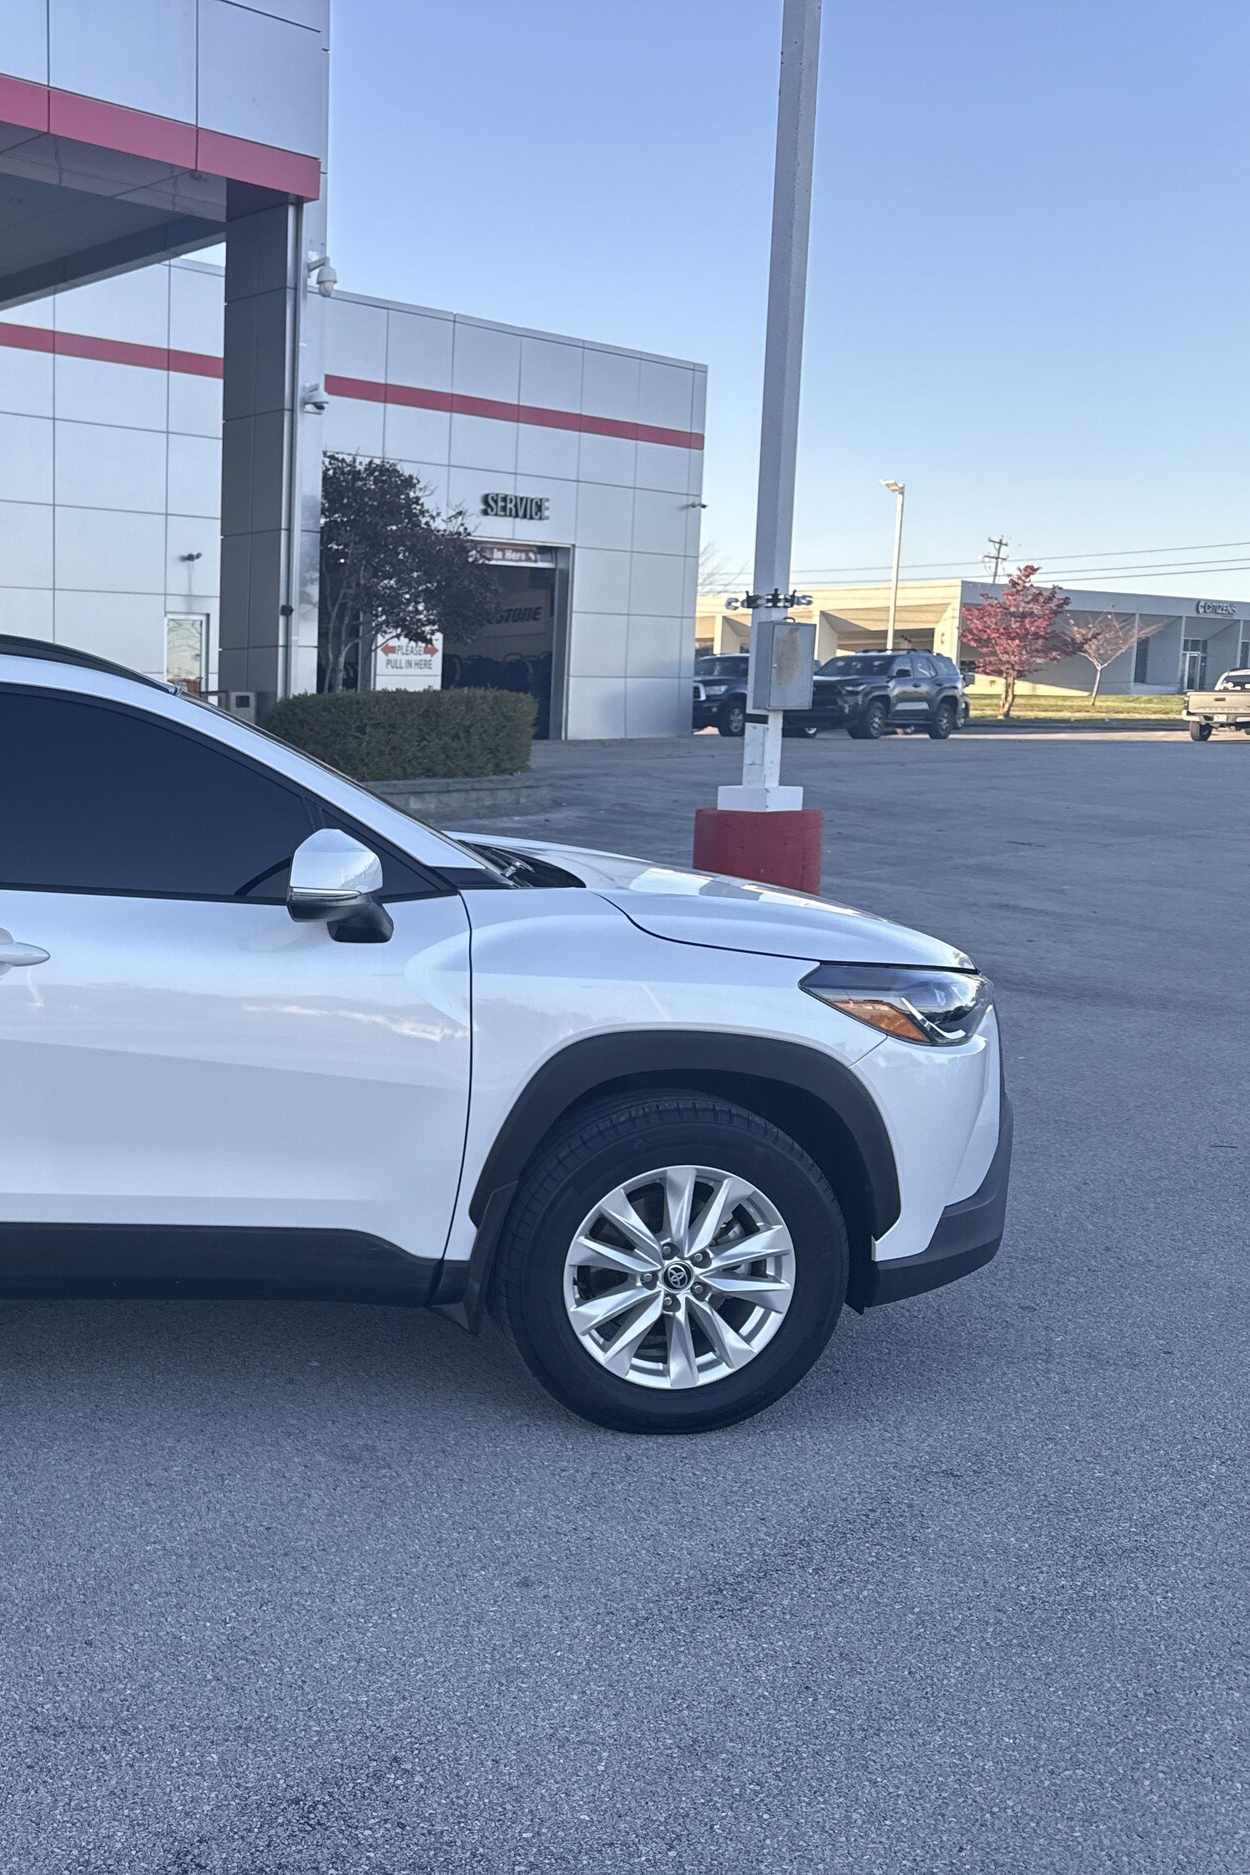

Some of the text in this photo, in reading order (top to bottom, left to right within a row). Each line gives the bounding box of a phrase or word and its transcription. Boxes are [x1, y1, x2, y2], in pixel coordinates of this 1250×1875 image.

[482, 493, 550, 520] SERVICE
[493, 548, 502, 559] In
[1205, 602, 1238, 615] CITIZENS
[396, 644, 423, 656] PLEASE
[386, 658, 433, 670] PULL IN HERE
